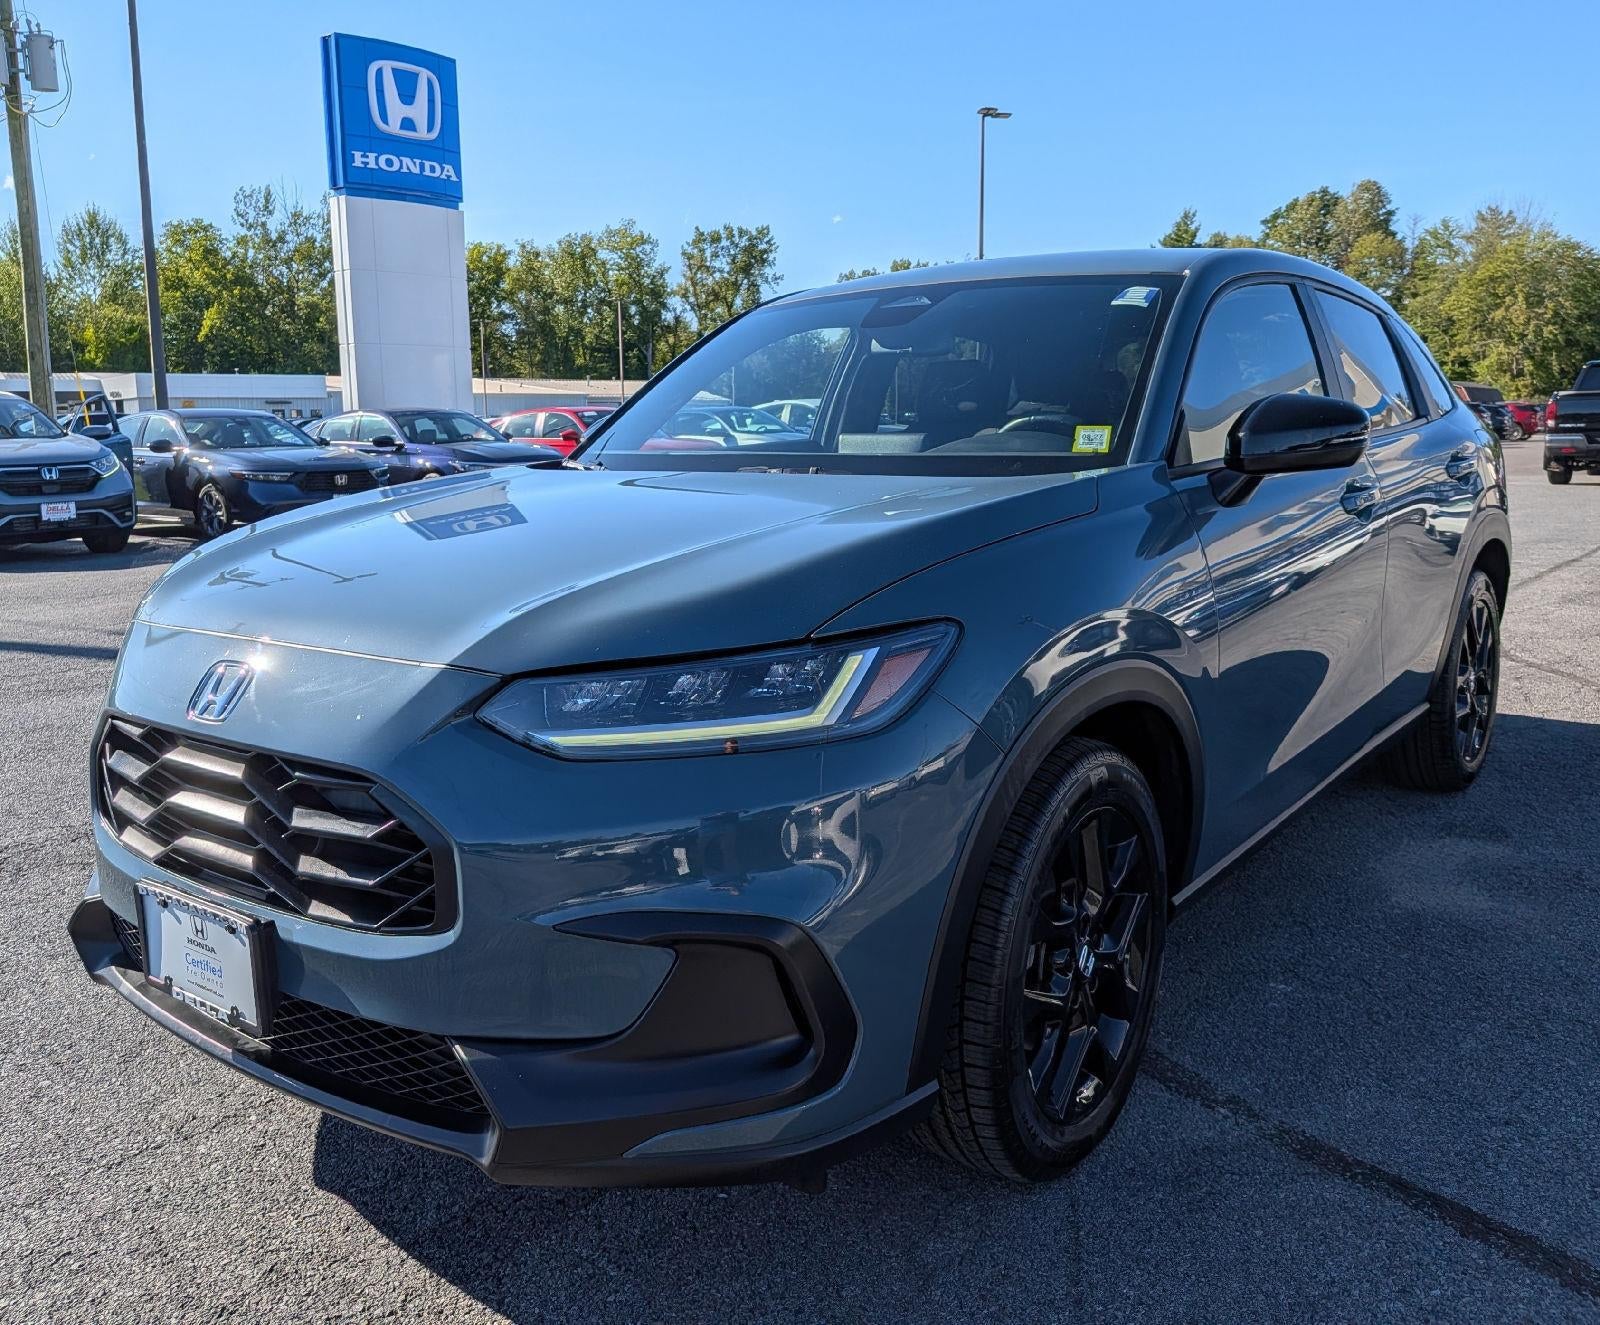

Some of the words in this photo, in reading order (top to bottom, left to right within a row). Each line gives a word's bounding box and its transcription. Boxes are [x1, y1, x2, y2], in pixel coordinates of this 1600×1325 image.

[351, 150, 460, 182] HONDA
[186, 936, 218, 955] HONDA
[185, 952, 223, 979] Certified
[172, 988, 230, 1024] DELLA
